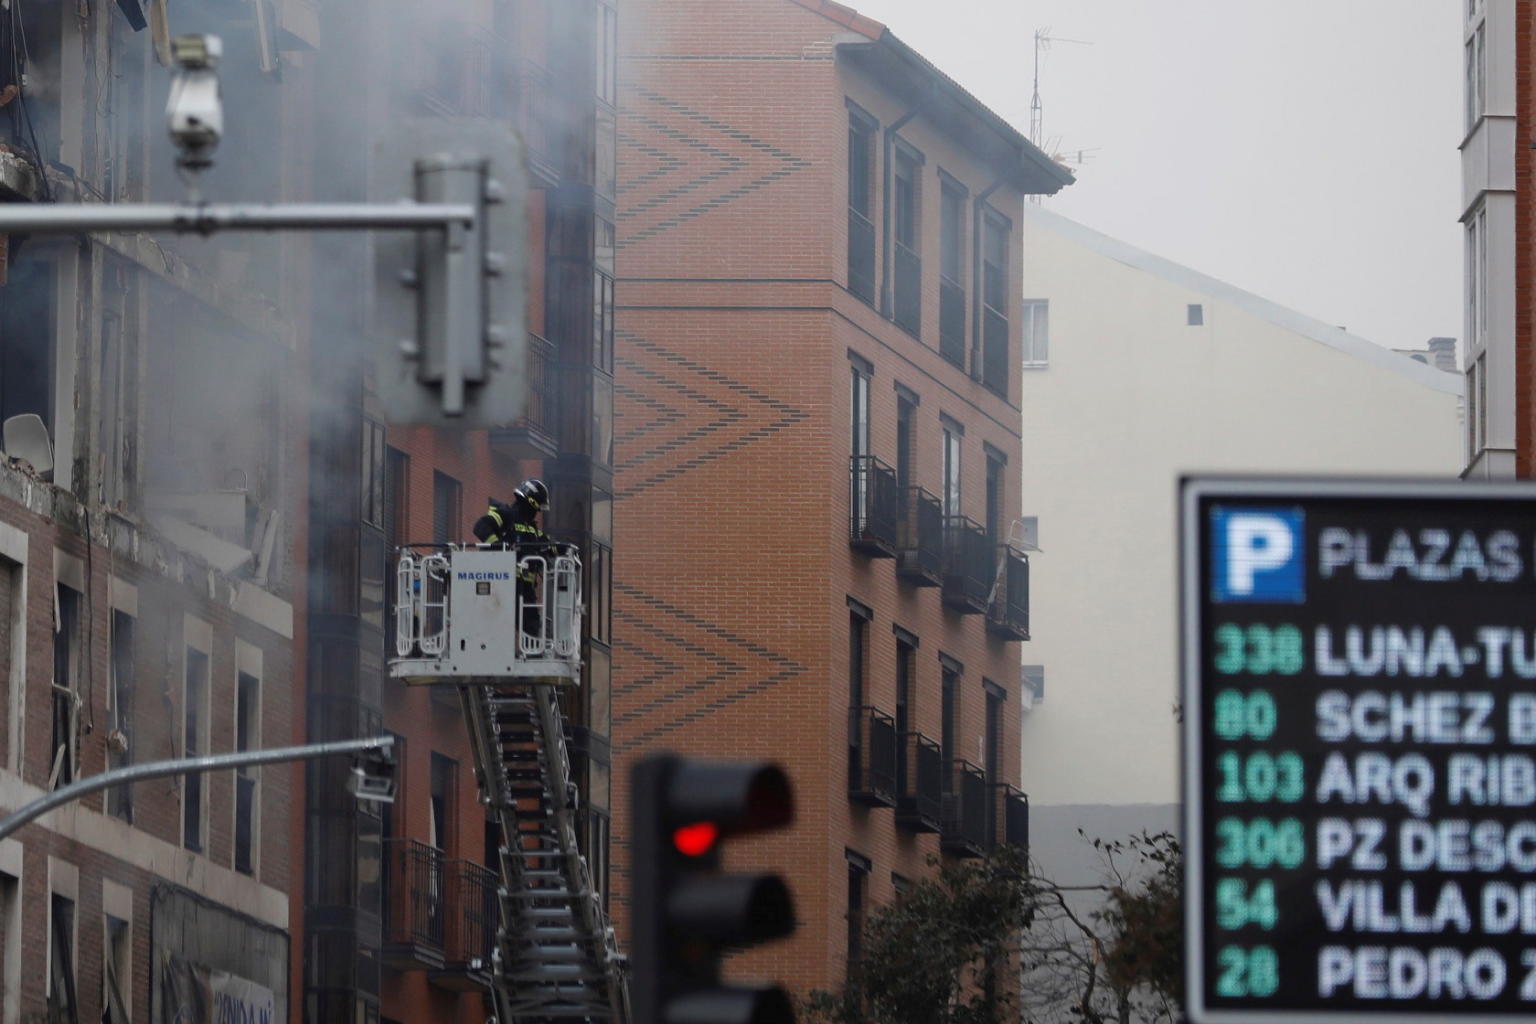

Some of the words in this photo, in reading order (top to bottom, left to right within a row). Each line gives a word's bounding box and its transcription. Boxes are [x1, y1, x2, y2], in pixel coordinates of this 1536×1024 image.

[457, 572, 510, 580] MAGIRUS
[1226, 513, 1294, 595] P
[1318, 527, 1522, 582] PLAZAS
[1215, 623, 1303, 675] 338
[1214, 689, 1276, 740] 80
[1315, 690, 1495, 743] SCHEZ
[1217, 751, 1304, 802] 103
[1316, 751, 1434, 817] ARQ
[1447, 753, 1536, 806] RIB
[1216, 818, 1304, 869] 306
[1316, 818, 1387, 871] PZ
[1399, 819, 1536, 872] DESC
[1215, 878, 1277, 930] 54
[1315, 879, 1471, 933] VILLA
[1216, 945, 1279, 996] 28
[1317, 945, 1507, 999] PEDRO
